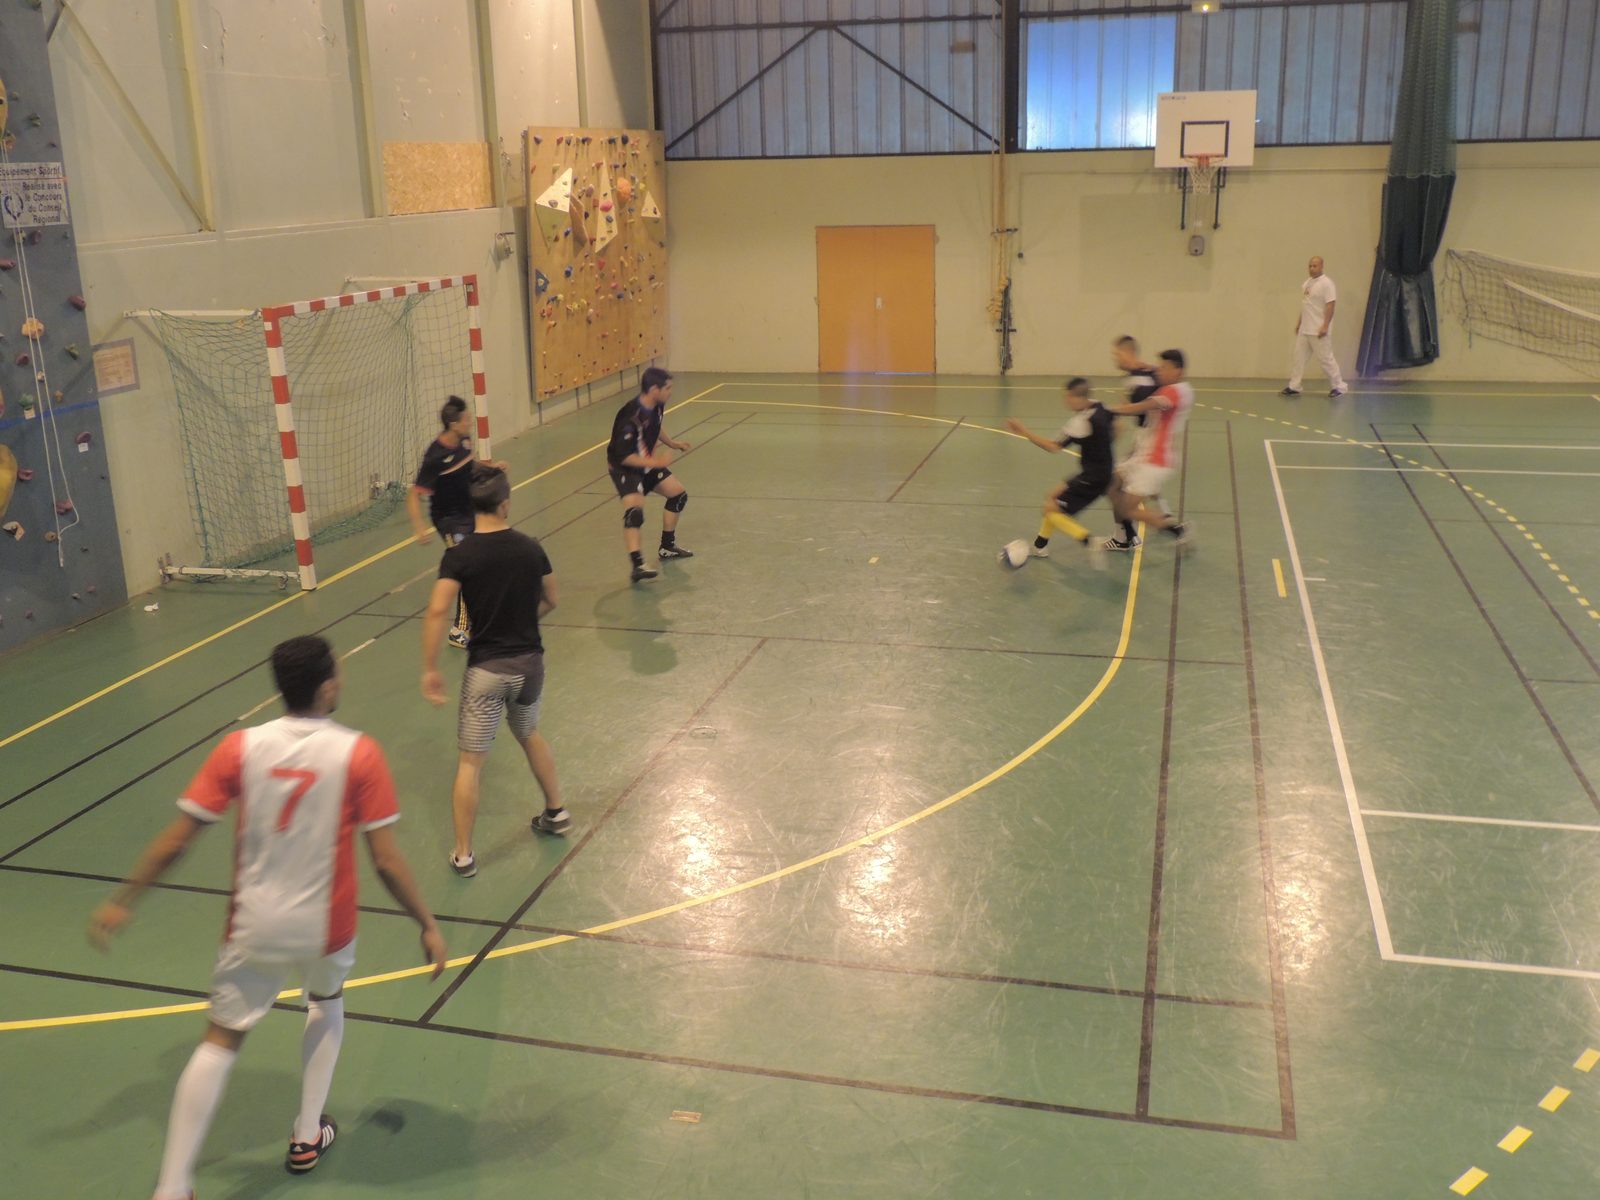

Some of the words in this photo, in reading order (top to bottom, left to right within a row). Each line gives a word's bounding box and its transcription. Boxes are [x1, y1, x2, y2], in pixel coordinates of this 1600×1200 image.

[47, 182, 62, 190] avec
[33, 192, 62, 202] Concours
[271, 767, 316, 832] 7
